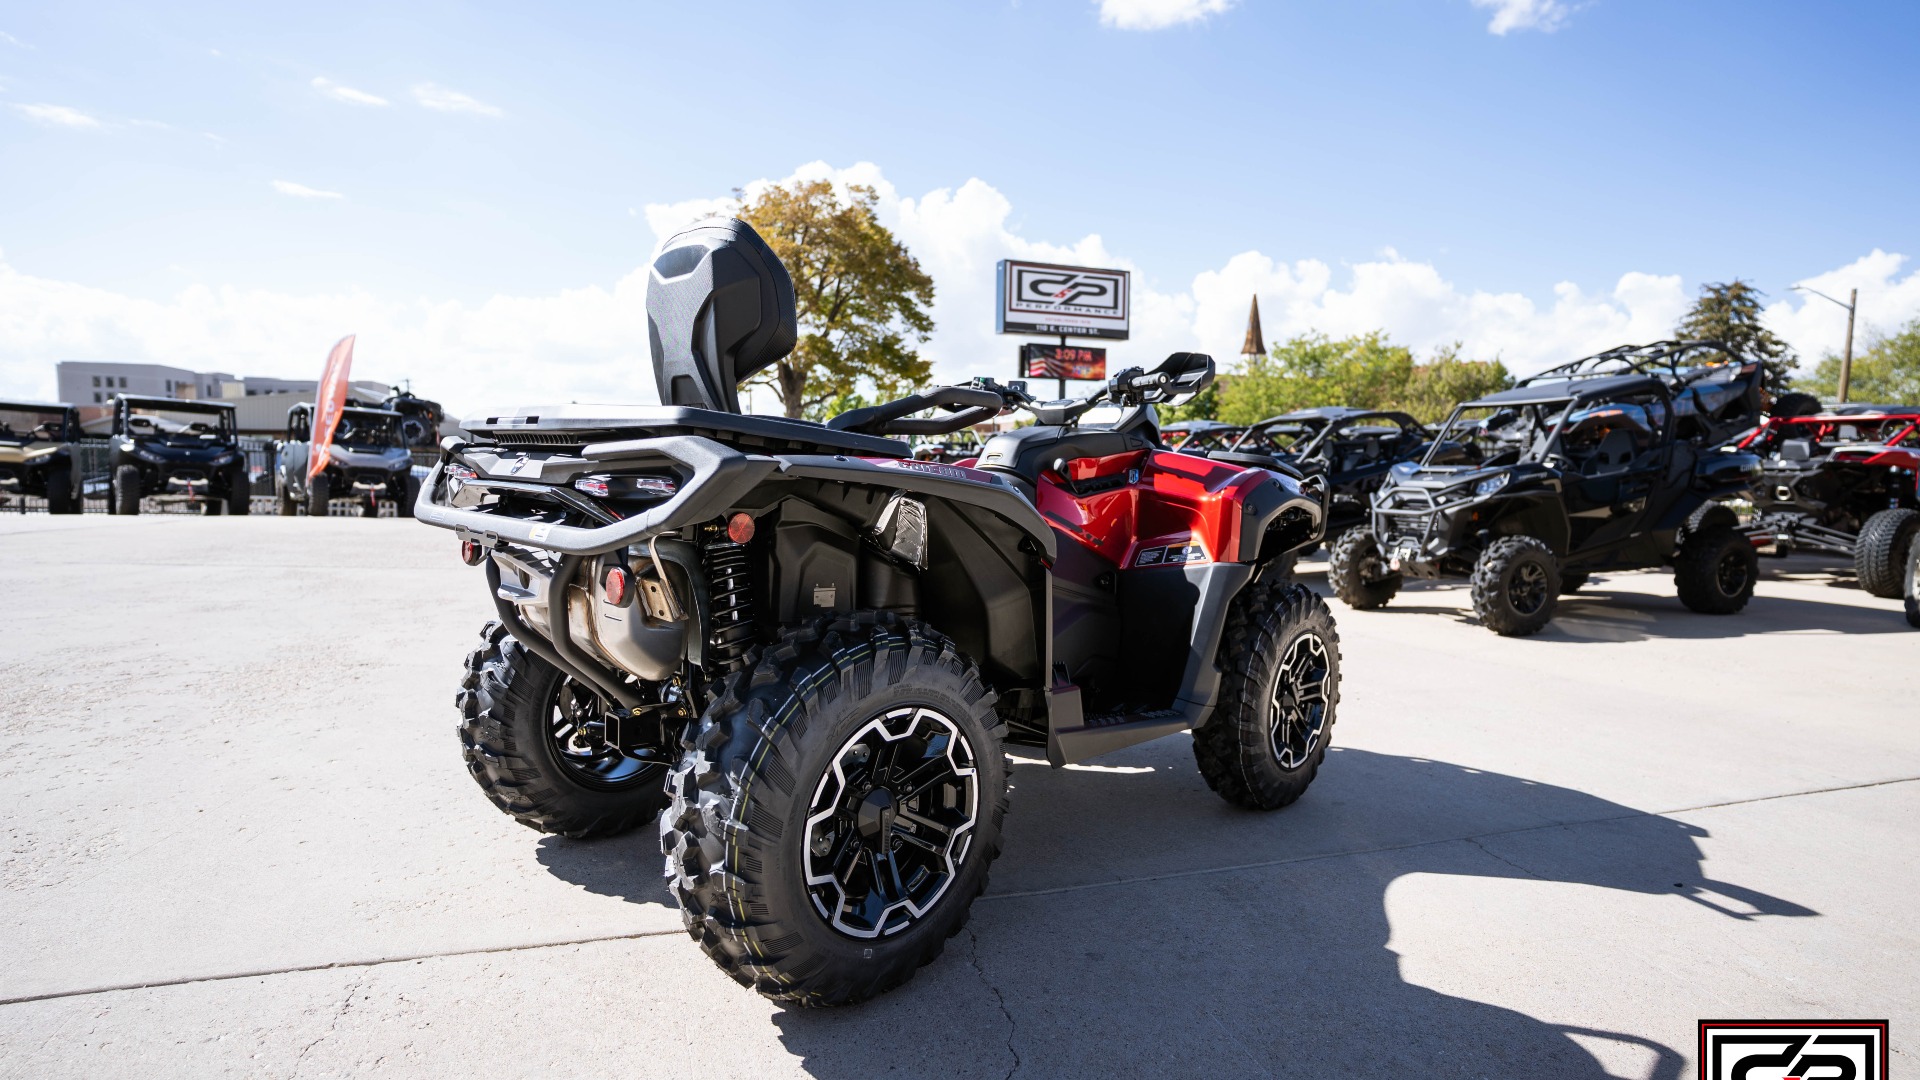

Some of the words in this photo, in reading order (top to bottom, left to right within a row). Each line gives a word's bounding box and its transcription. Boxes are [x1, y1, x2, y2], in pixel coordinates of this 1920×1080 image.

[1016, 302, 1119, 315] PERFORMANCE
[1055, 348, 1076, 360] 3:09
[1078, 350, 1092, 361] PM
